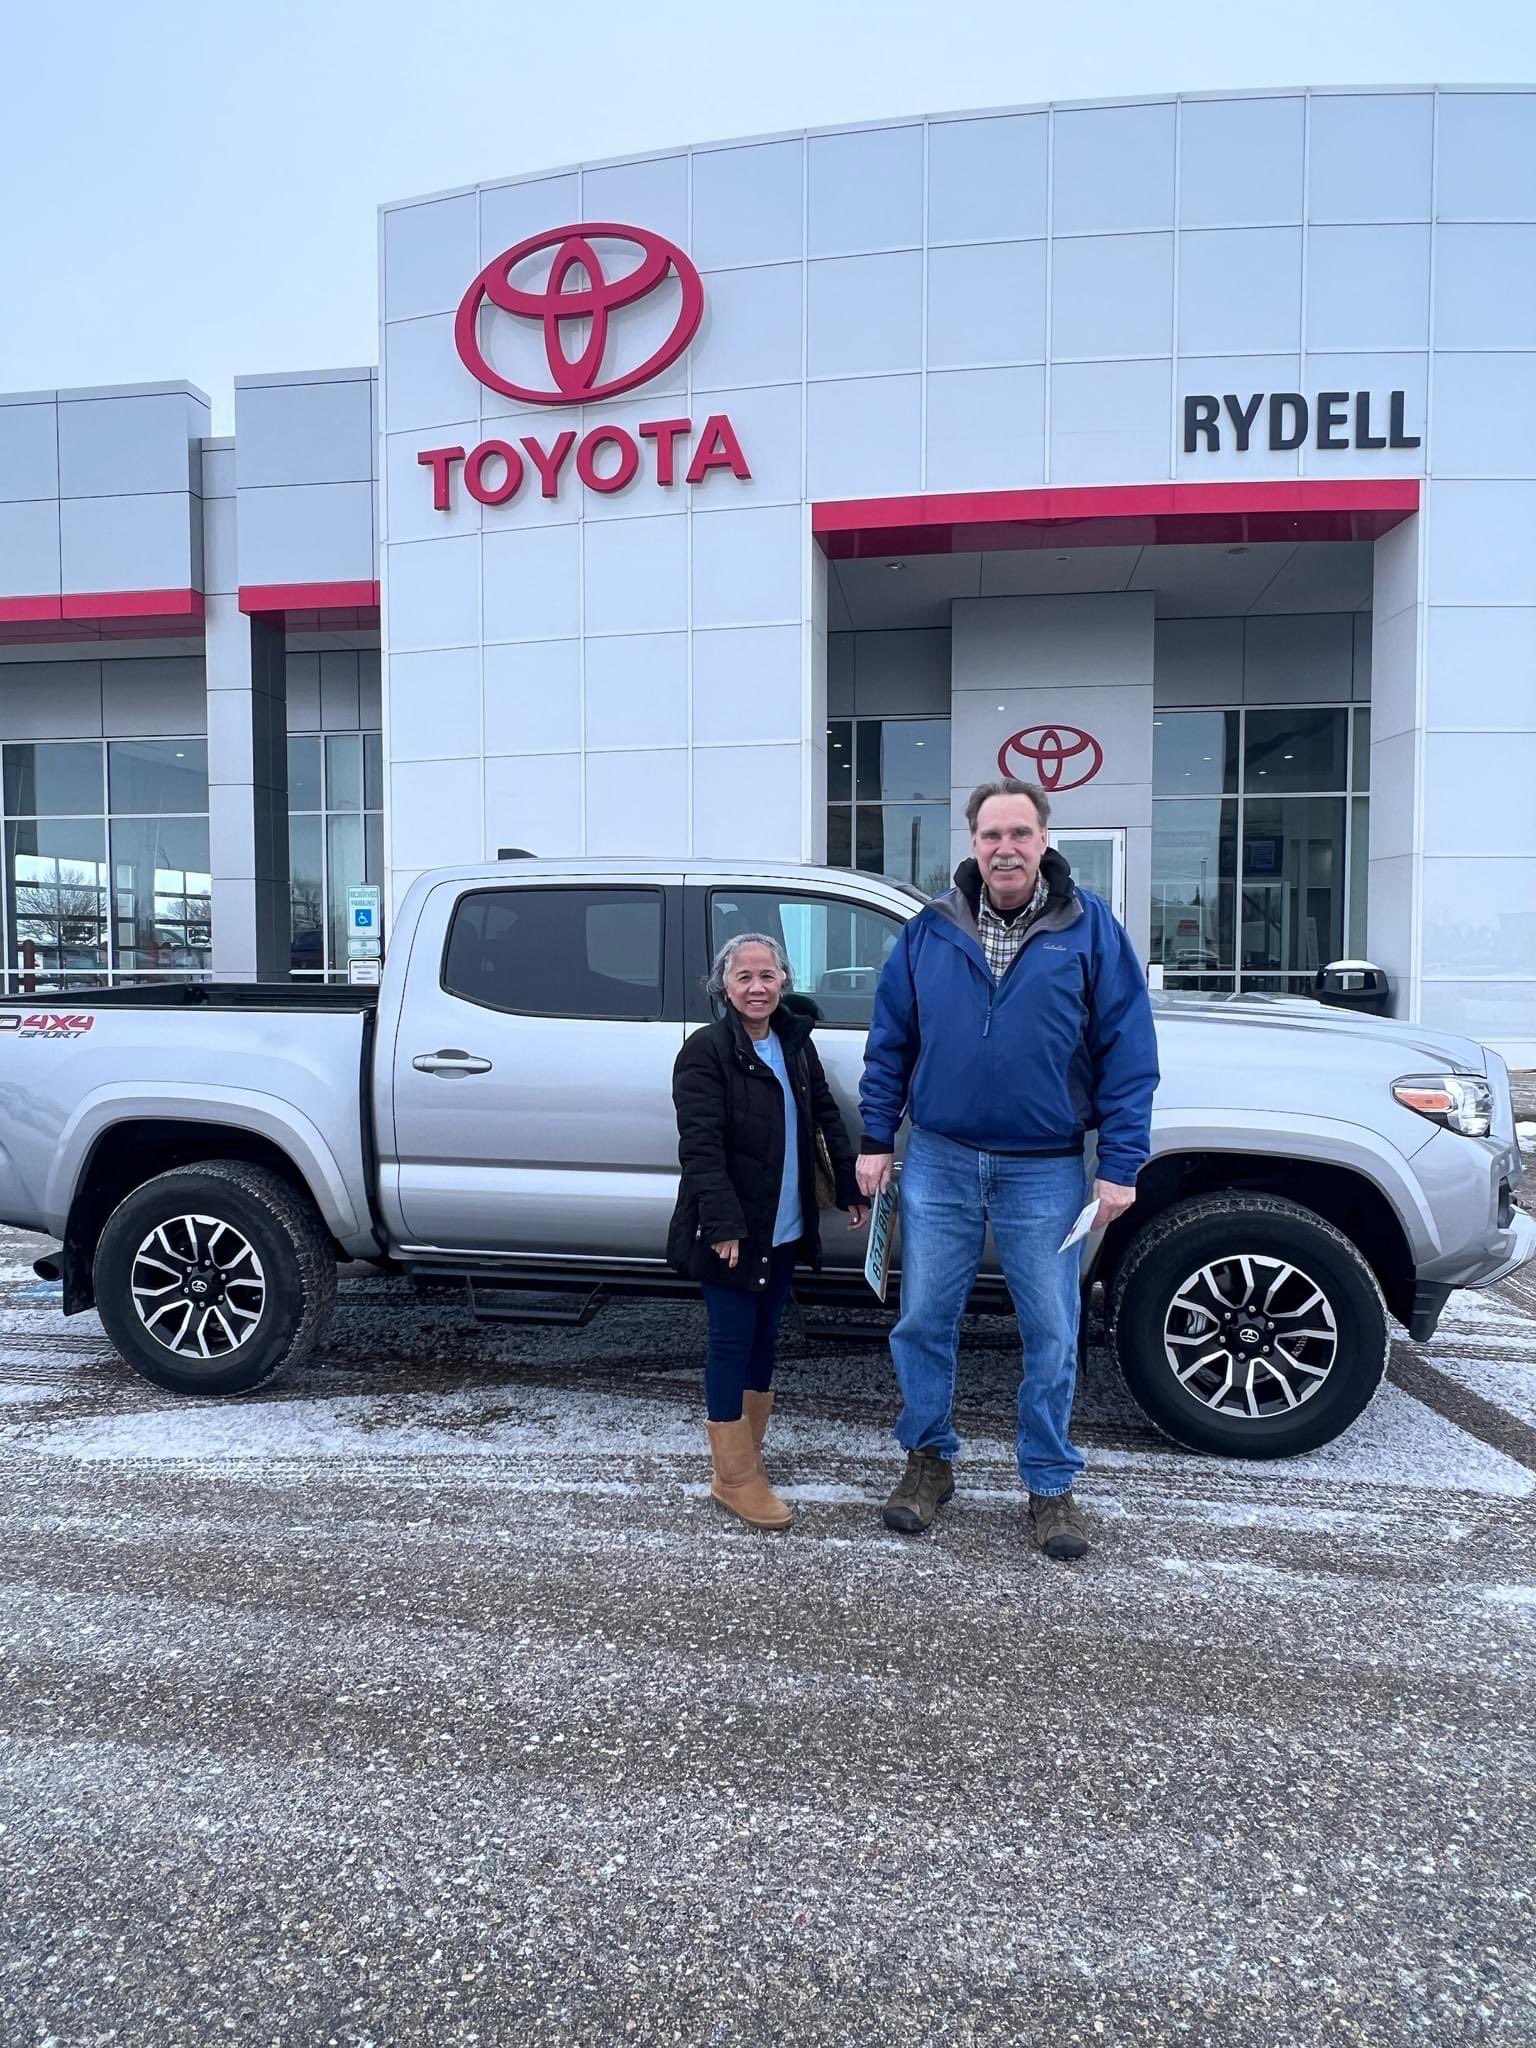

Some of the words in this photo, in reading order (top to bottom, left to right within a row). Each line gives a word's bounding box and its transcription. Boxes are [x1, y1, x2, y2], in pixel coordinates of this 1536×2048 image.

[1184, 391, 1421, 453] RYDELL
[418, 415, 751, 511] TOYOTA
[18, 1031, 86, 1039] SPORT
